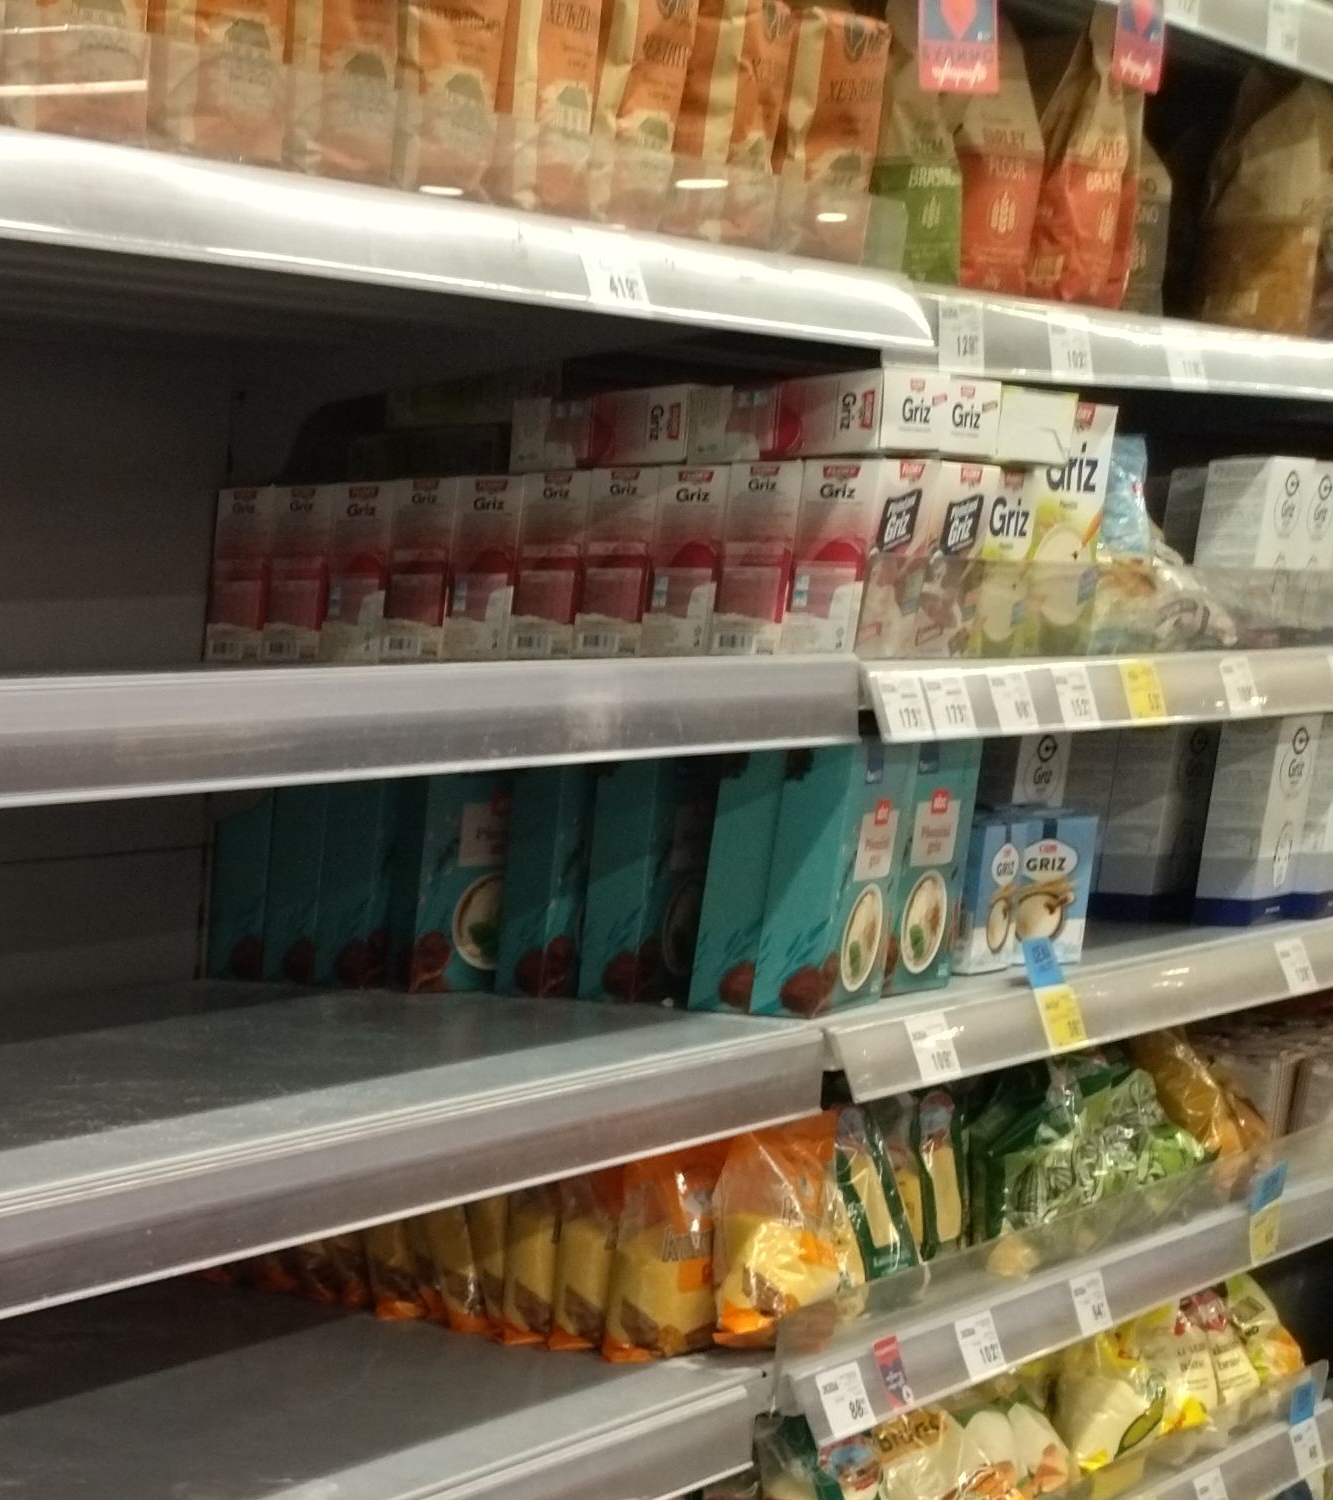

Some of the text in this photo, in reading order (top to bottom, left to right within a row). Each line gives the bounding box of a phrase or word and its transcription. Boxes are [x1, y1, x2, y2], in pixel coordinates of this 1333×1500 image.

[902, 395, 931, 424] Griz
[952, 404, 980, 429] Griz
[676, 487, 711, 506] Griz
[820, 483, 856, 501] Griz
[990, 497, 1030, 538] Griz
[1026, 856, 1065, 871] GRIZ
